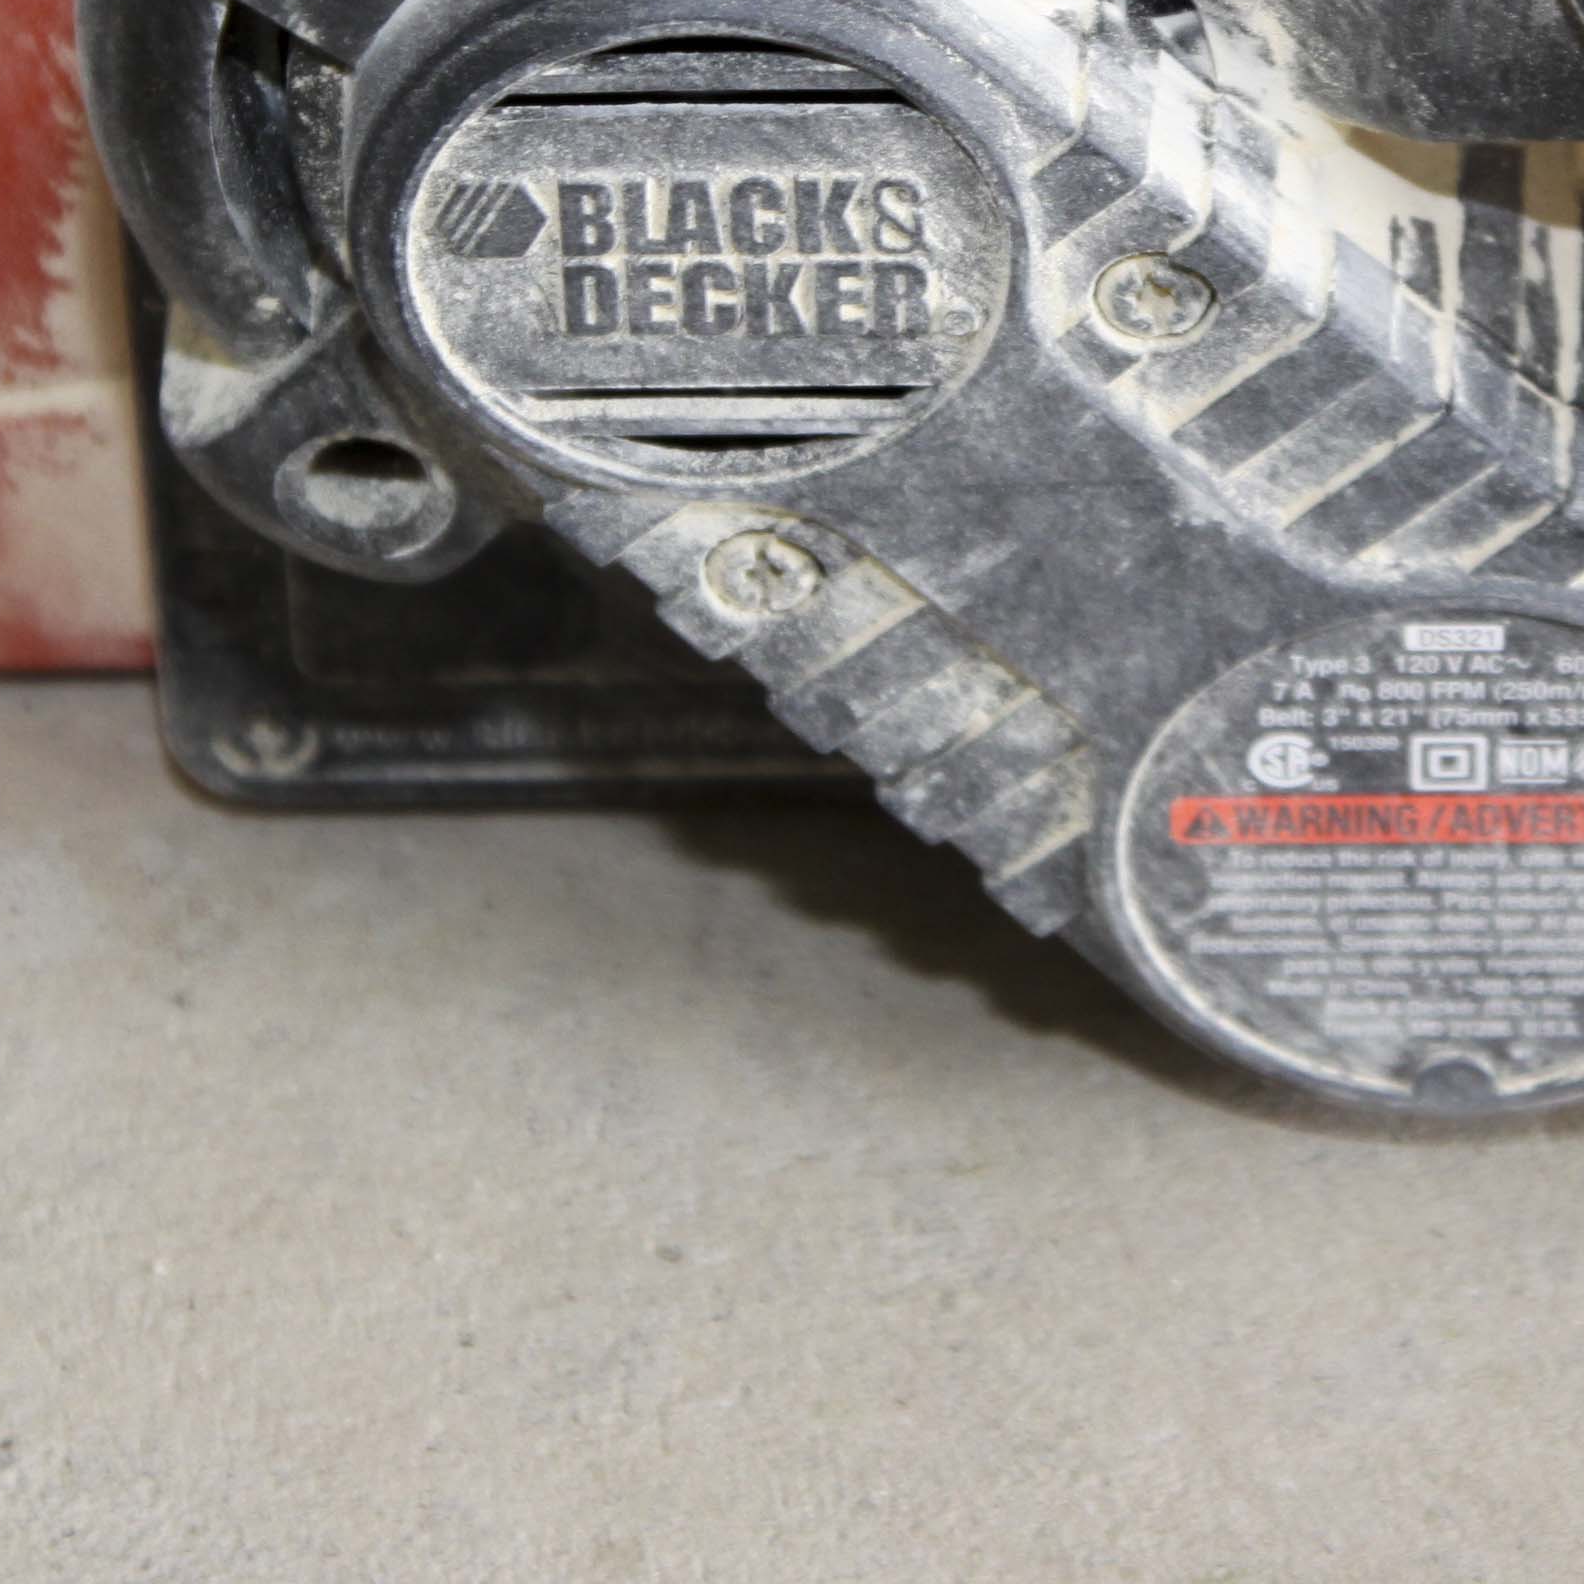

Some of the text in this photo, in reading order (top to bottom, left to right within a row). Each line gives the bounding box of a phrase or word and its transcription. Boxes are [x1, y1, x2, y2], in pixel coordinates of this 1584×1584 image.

[564, 262, 929, 335] DECKER
[1419, 629, 1497, 647] DS321
[1289, 655, 1348, 677] Type
[1354, 655, 1370, 674] 3
[1394, 655, 1440, 674] 120
[1445, 655, 1463, 674] V
[1272, 681, 1289, 701] 7
[1293, 681, 1314, 701] A
[1376, 681, 1425, 701] 800
[1430, 681, 1486, 701] FPM
[1257, 706, 1314, 727] Belt:
